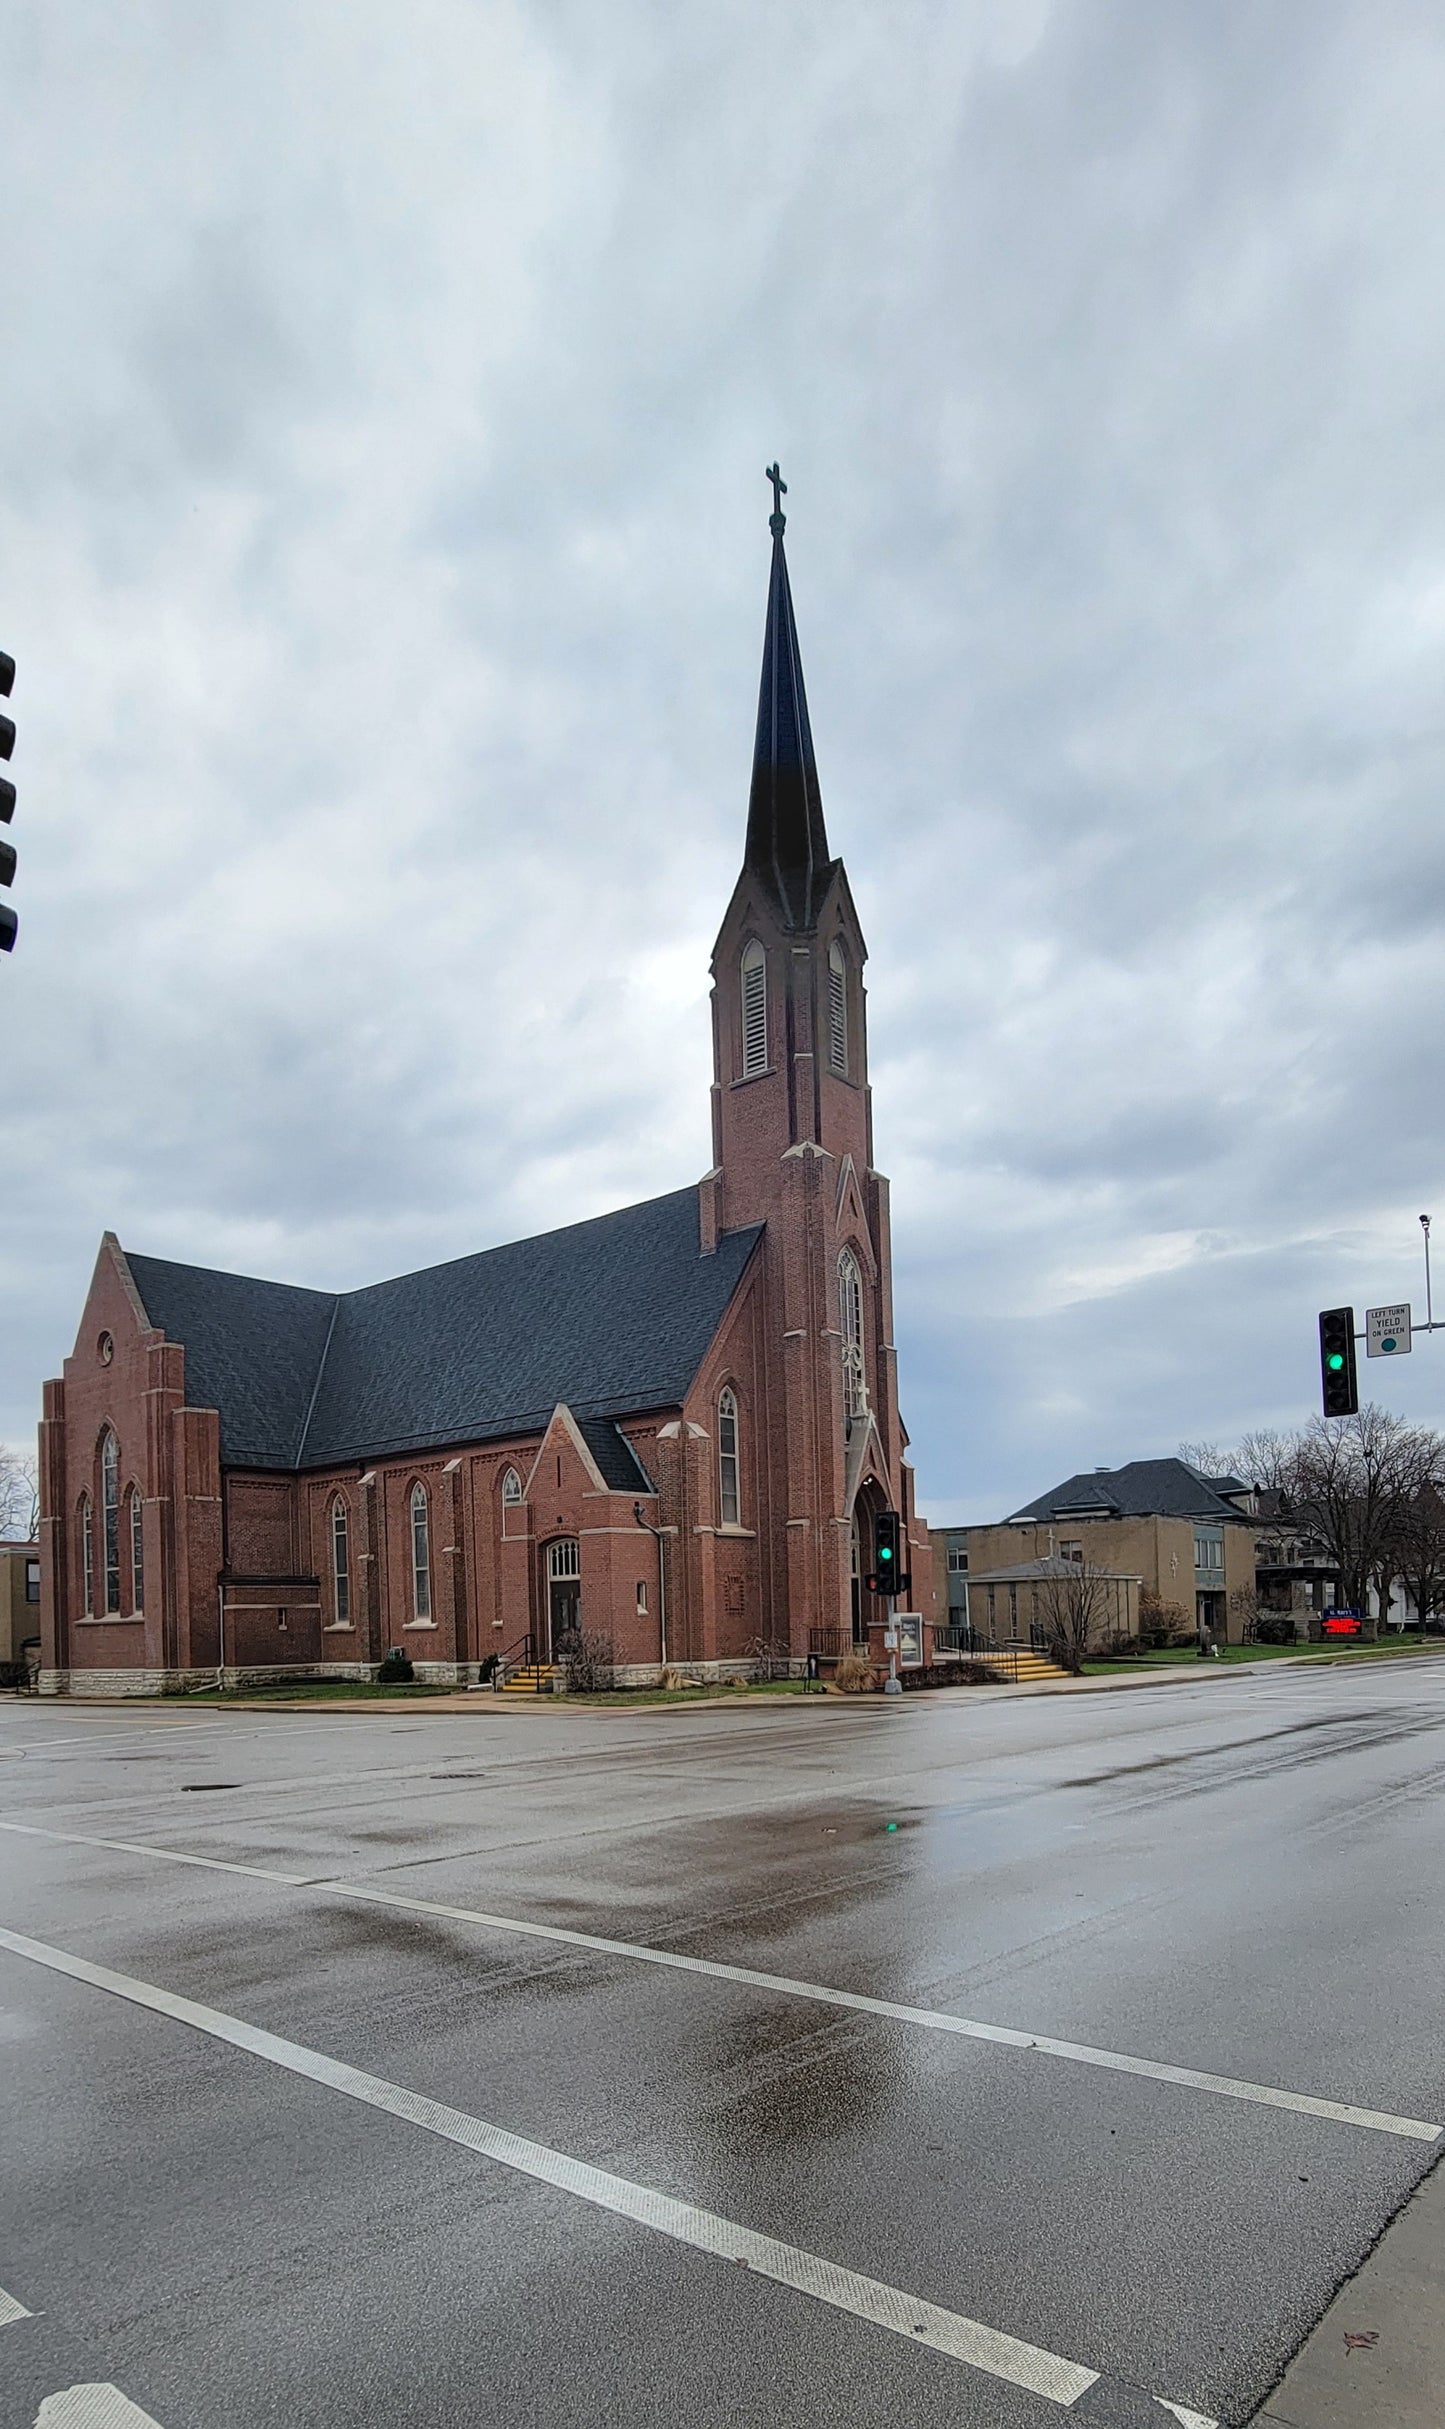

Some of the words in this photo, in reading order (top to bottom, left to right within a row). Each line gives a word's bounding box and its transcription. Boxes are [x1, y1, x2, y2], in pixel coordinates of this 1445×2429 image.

[1389, 1308, 1405, 1316] TURN
[1376, 1318, 1400, 1327] YIELD
[1384, 1327, 1405, 1335] GREEN
